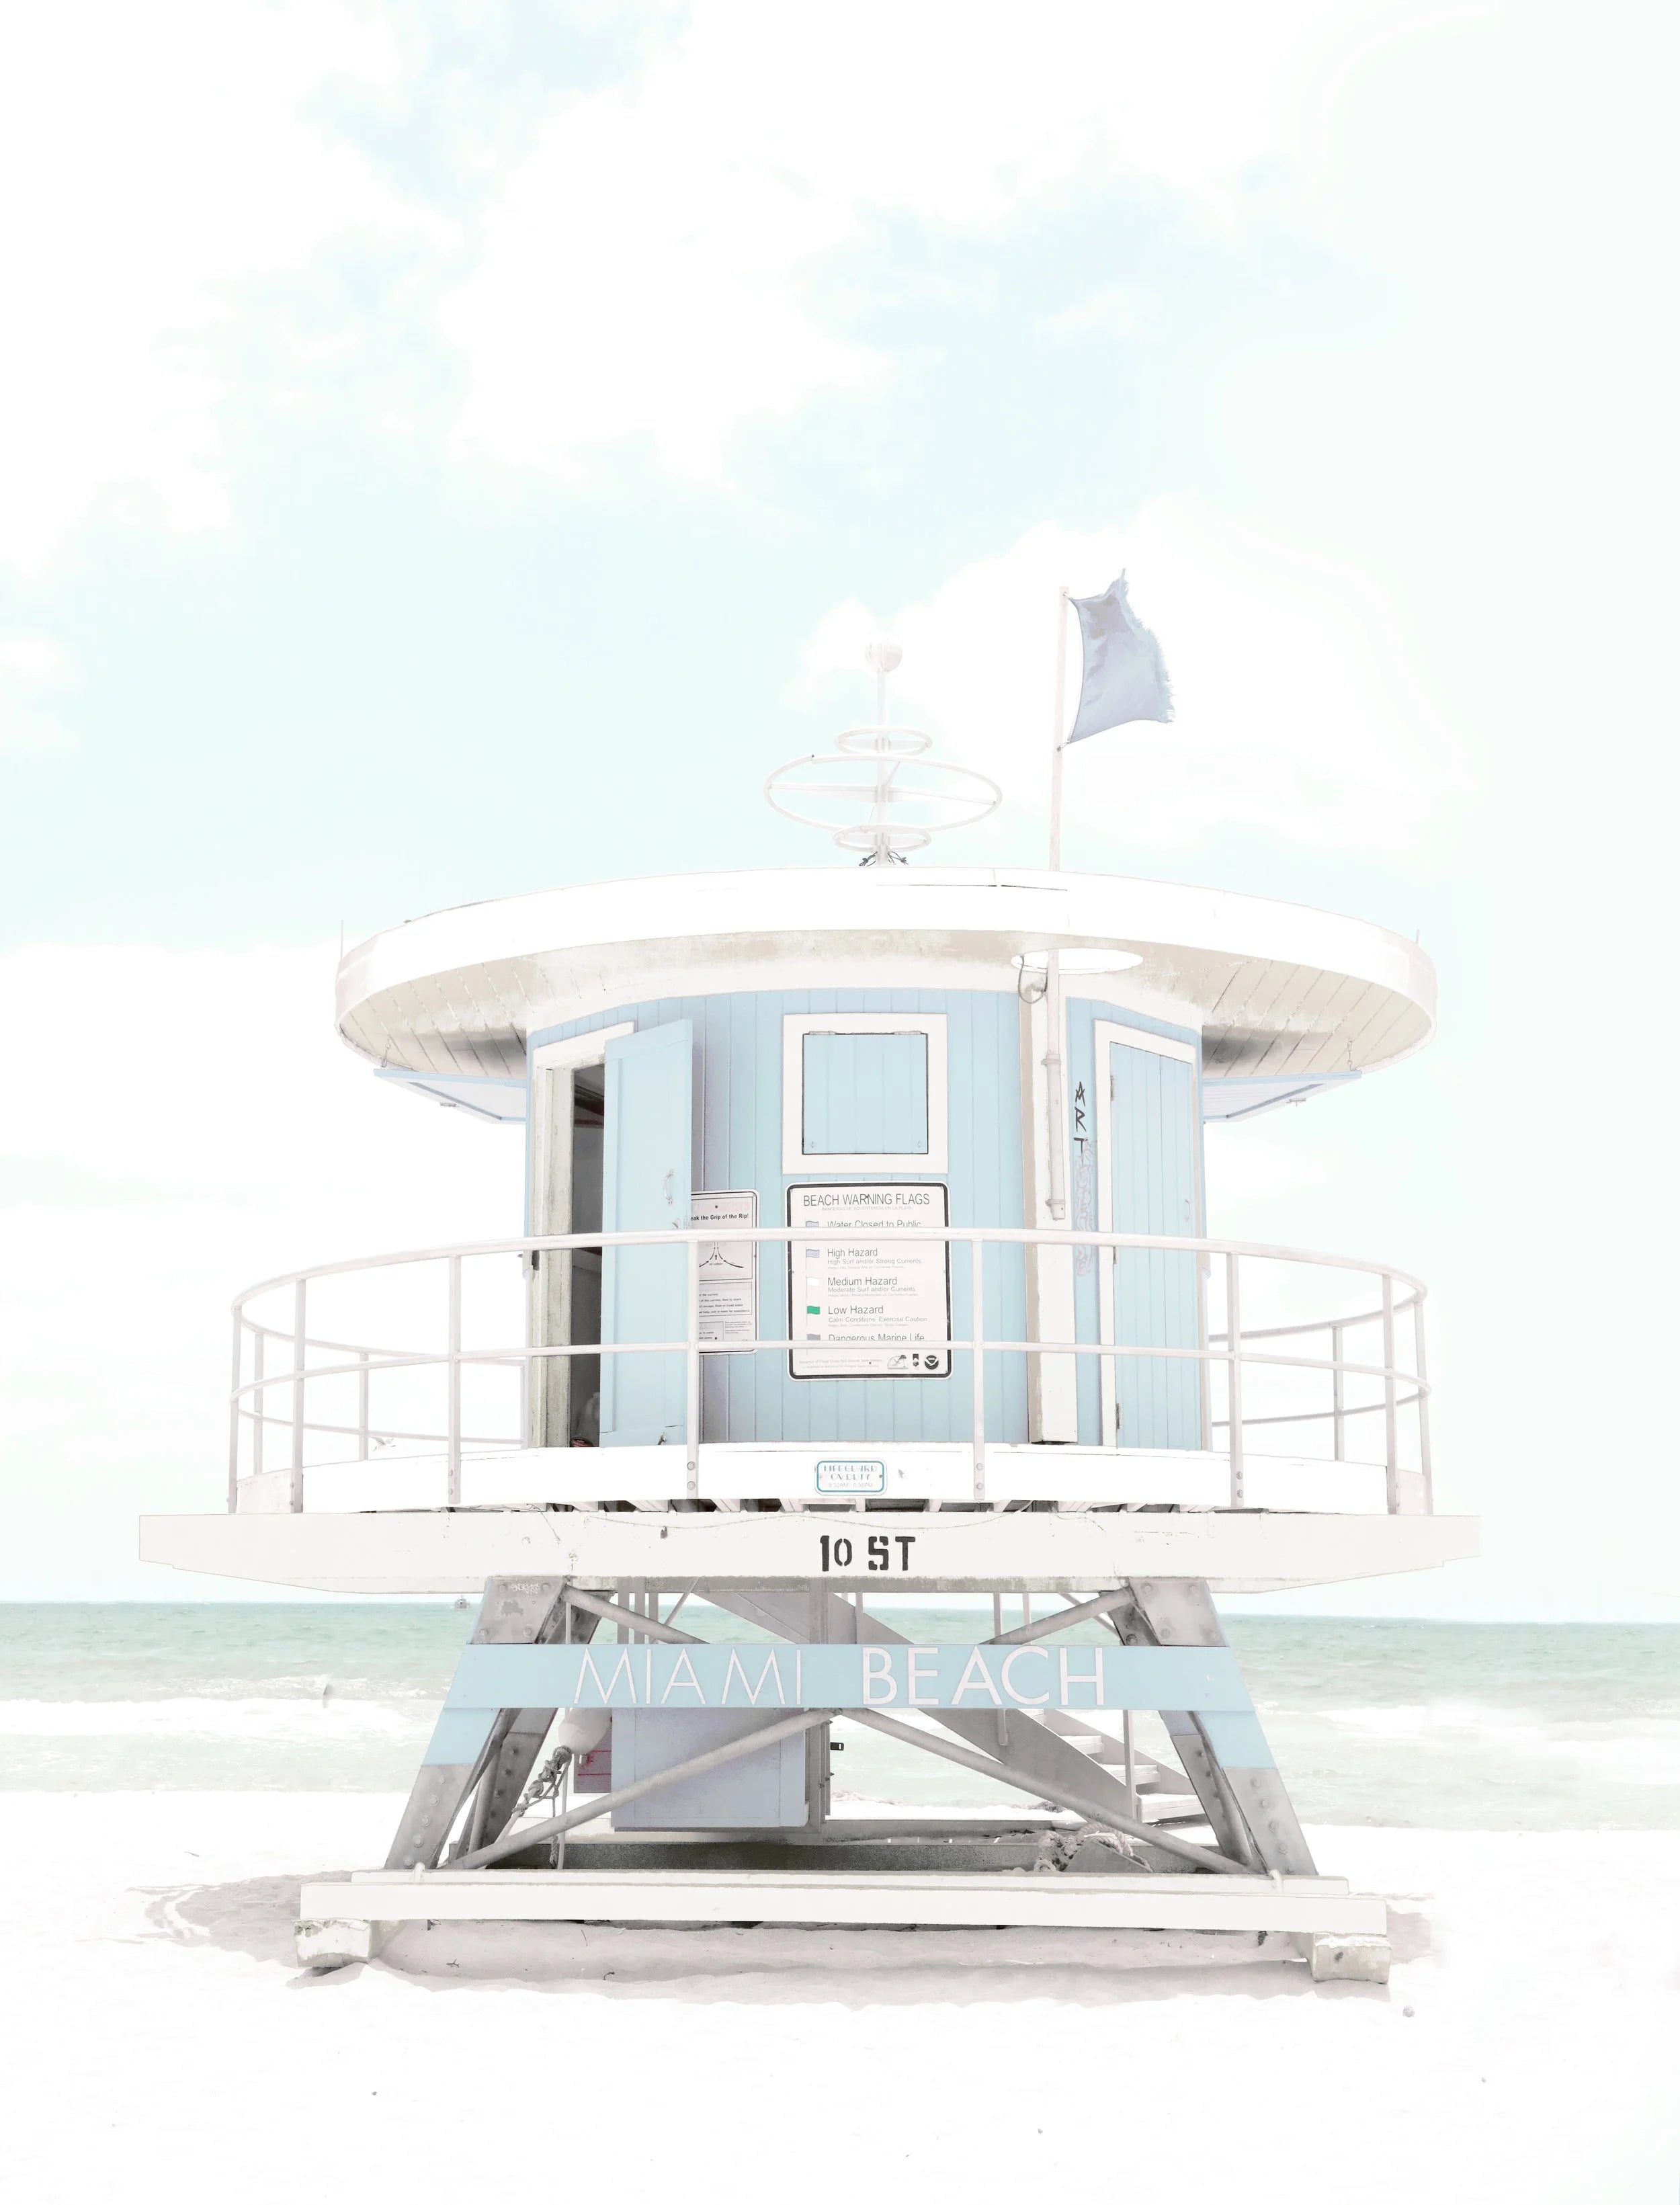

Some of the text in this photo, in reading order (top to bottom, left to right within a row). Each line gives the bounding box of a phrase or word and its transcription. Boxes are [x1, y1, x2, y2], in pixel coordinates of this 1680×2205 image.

[804, 1194, 930, 1206] BEACH WARNING FLAGS
[827, 1248, 878, 1259] High Hazard
[828, 1276, 897, 1286] Medium Hazard
[828, 1305, 884, 1315] Low Hazard
[820, 1535, 915, 1571] 10 ST
[574, 1647, 1104, 1706] MIAMI BEACH
